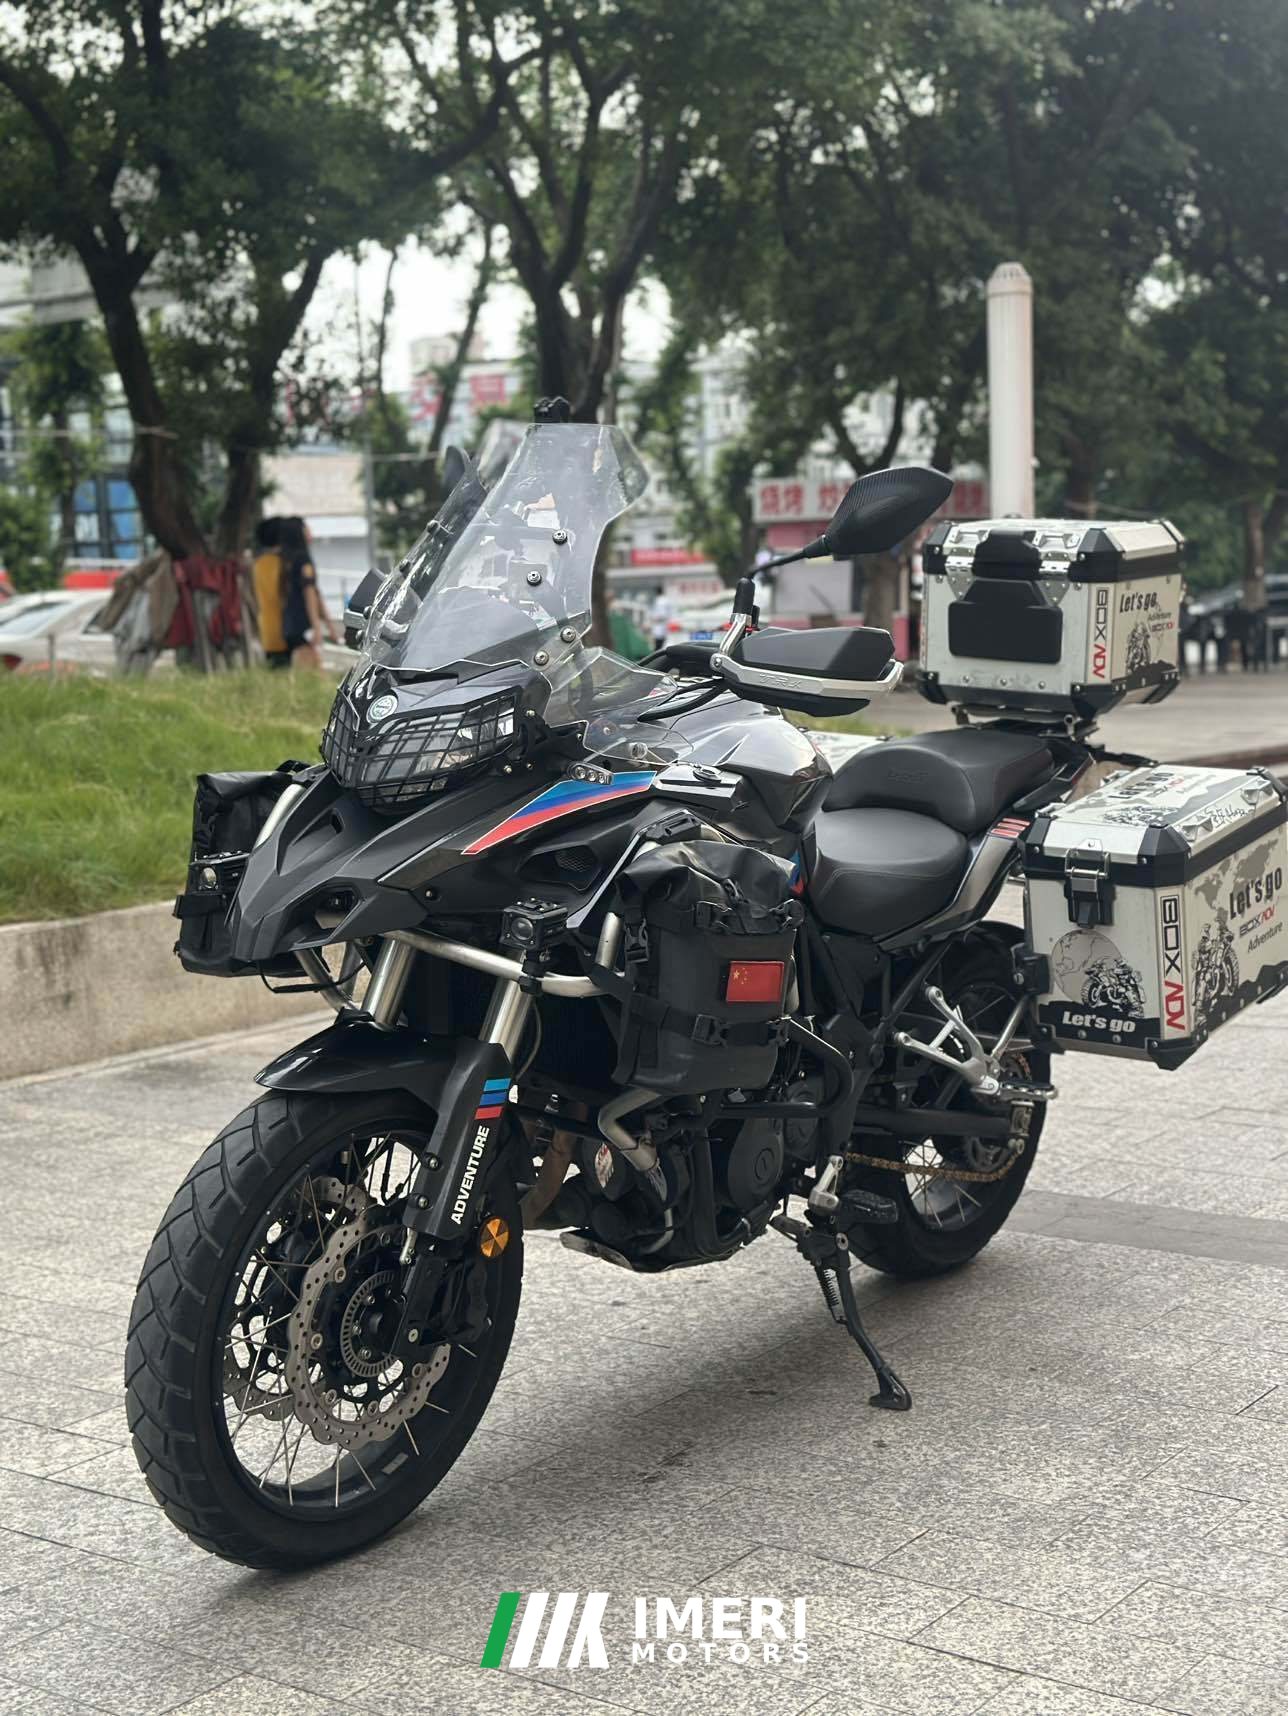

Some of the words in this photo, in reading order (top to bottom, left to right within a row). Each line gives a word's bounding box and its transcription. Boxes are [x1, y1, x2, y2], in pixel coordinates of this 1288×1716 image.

[1096, 589, 1108, 641] BOX
[1119, 592, 1143, 613] Let's
[1144, 591, 1158, 611] go
[1092, 643, 1107, 679] ADV
[1228, 880, 1263, 920] Let's
[1265, 866, 1283, 902] go
[1161, 897, 1182, 977] BOX
[1238, 913, 1261, 939] BOX
[1247, 921, 1283, 954] Adventure
[1062, 1010, 1106, 1030] Let's
[1109, 1018, 1137, 1034] go
[1164, 980, 1186, 1031] ADV
[450, 1125, 490, 1225] ADVENTURE
